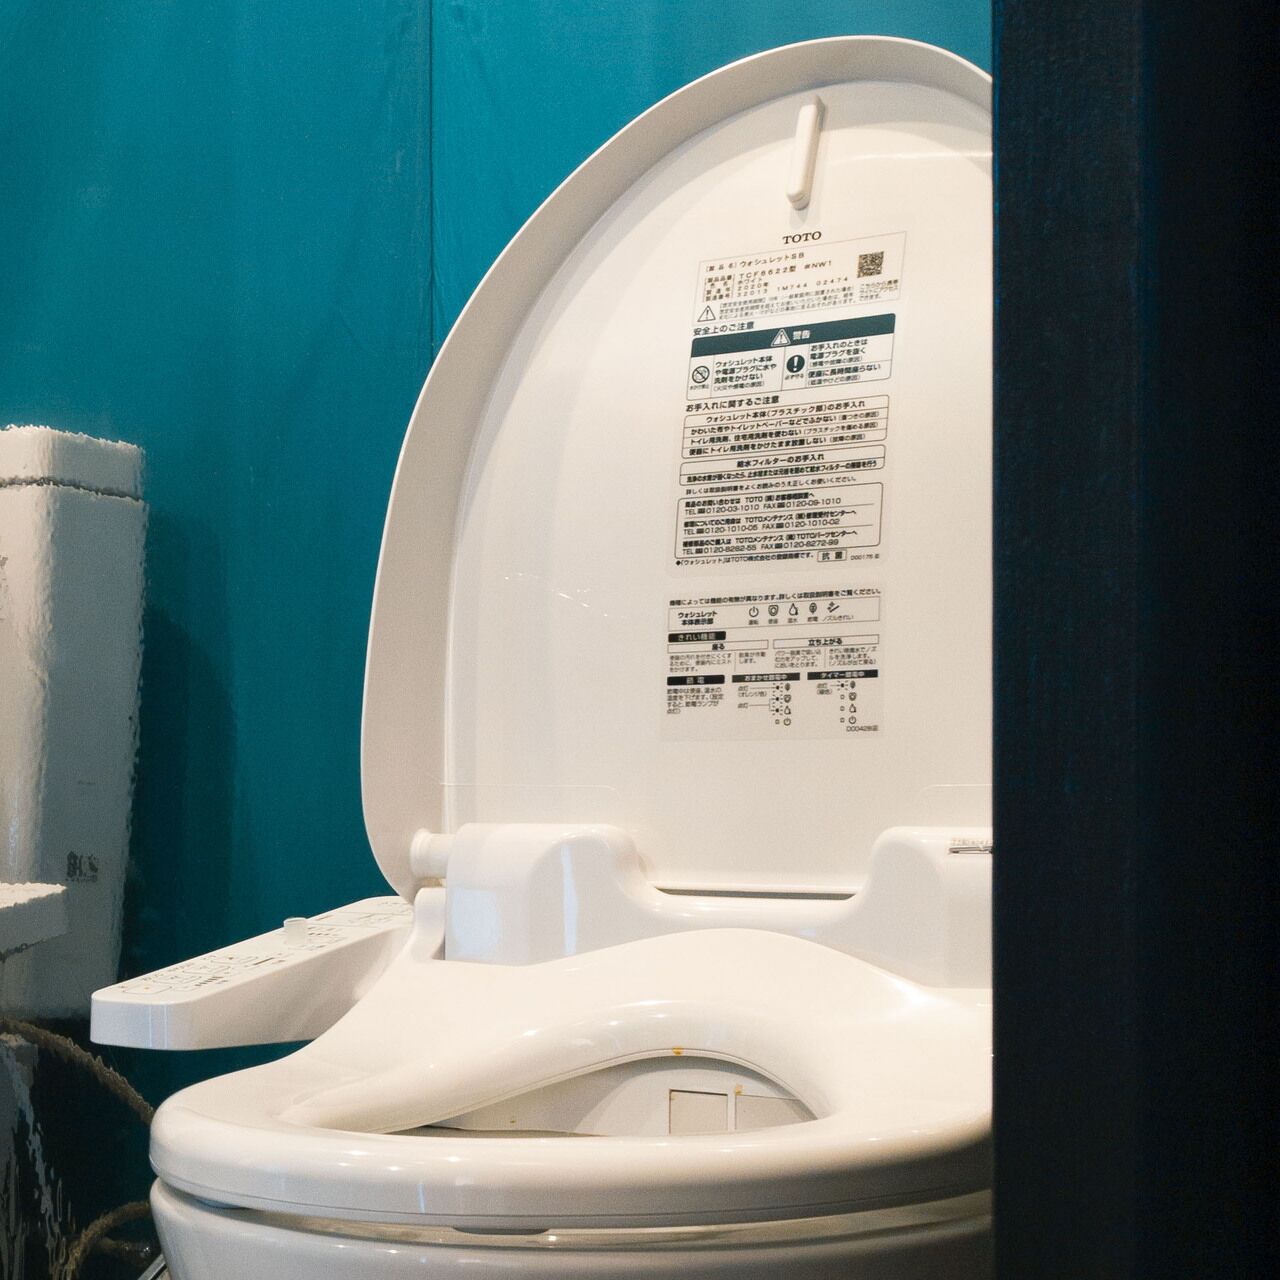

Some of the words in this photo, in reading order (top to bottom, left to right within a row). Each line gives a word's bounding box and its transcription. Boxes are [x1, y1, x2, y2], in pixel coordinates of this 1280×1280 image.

[782, 231, 822, 245] TOTO
[693, 321, 754, 336] 安全上のご注意
[811, 339, 868, 351] お手入れのときは
[686, 395, 780, 412] お手入れに関するご注意
[706, 504, 759, 513] 0120-03-1010
[678, 610, 718, 619] ウォシュレット
